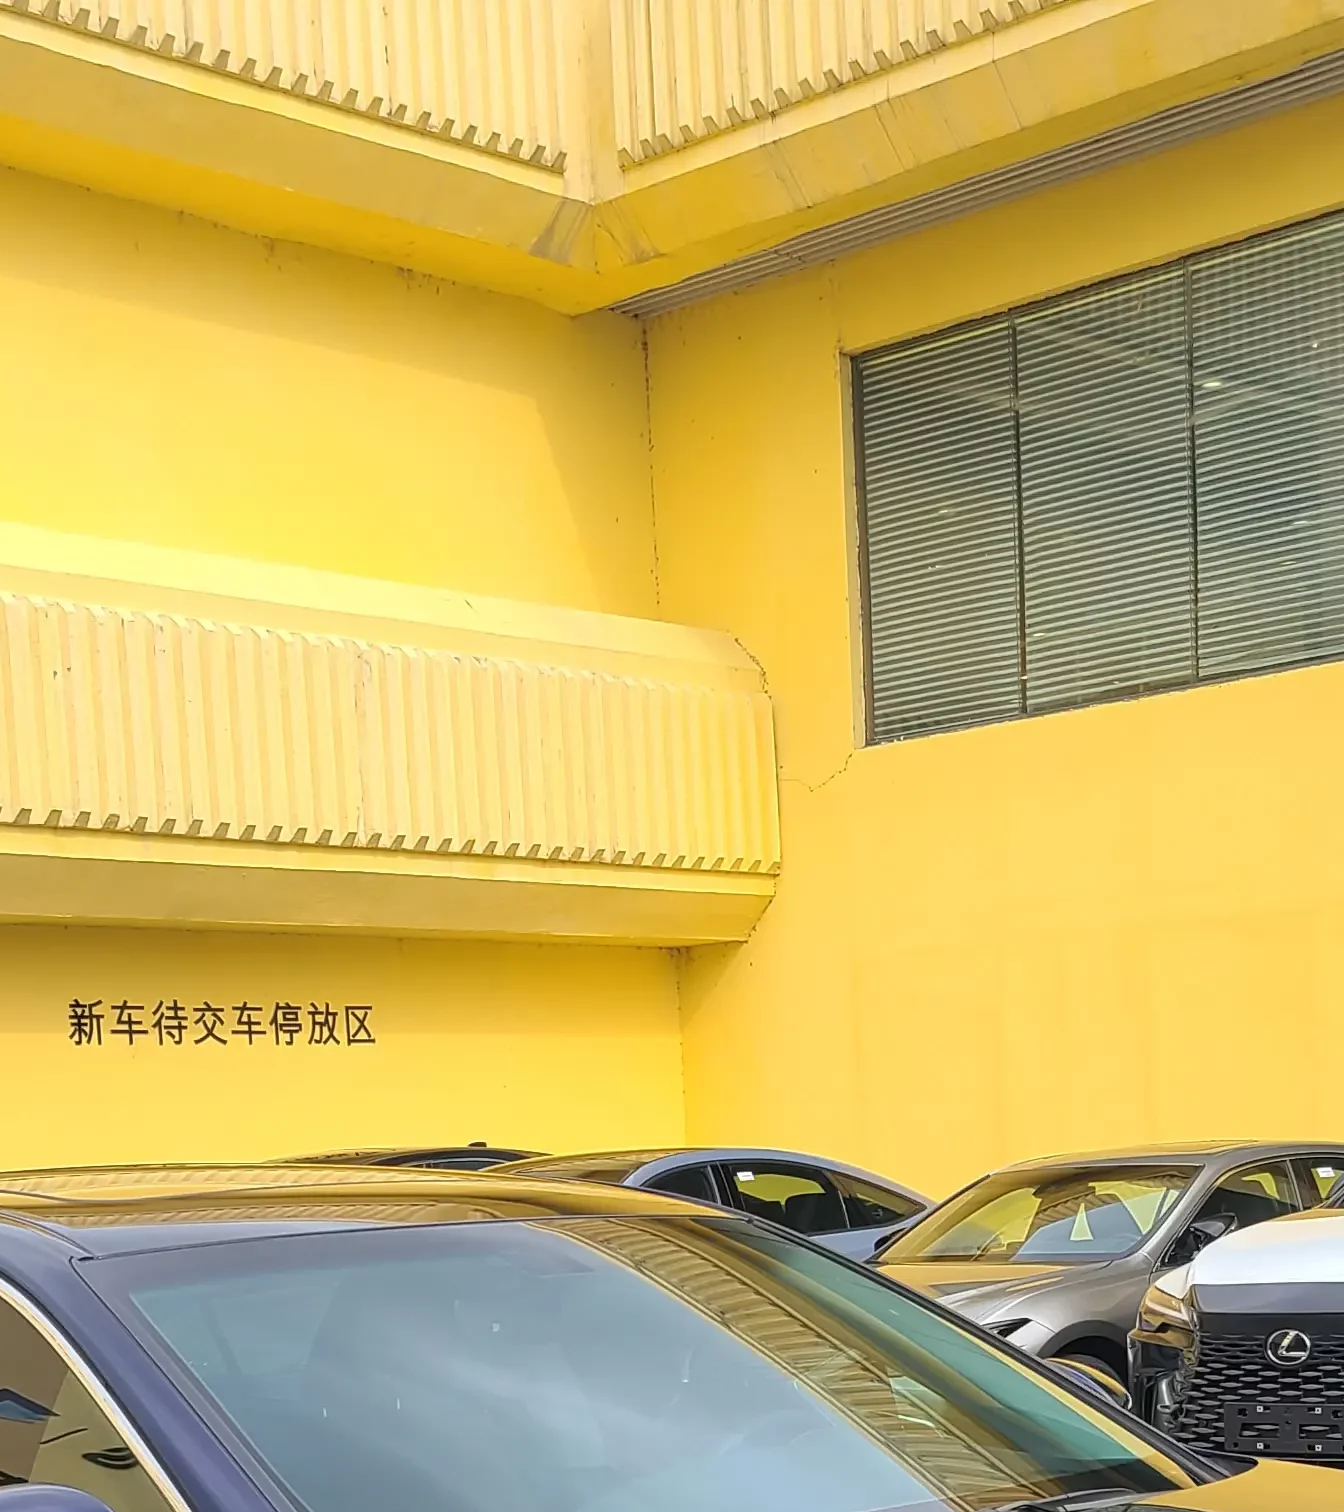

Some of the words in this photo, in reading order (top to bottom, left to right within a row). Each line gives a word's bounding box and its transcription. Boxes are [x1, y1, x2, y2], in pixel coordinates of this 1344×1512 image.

[68, 998, 377, 1047] 新车待交车停放区
